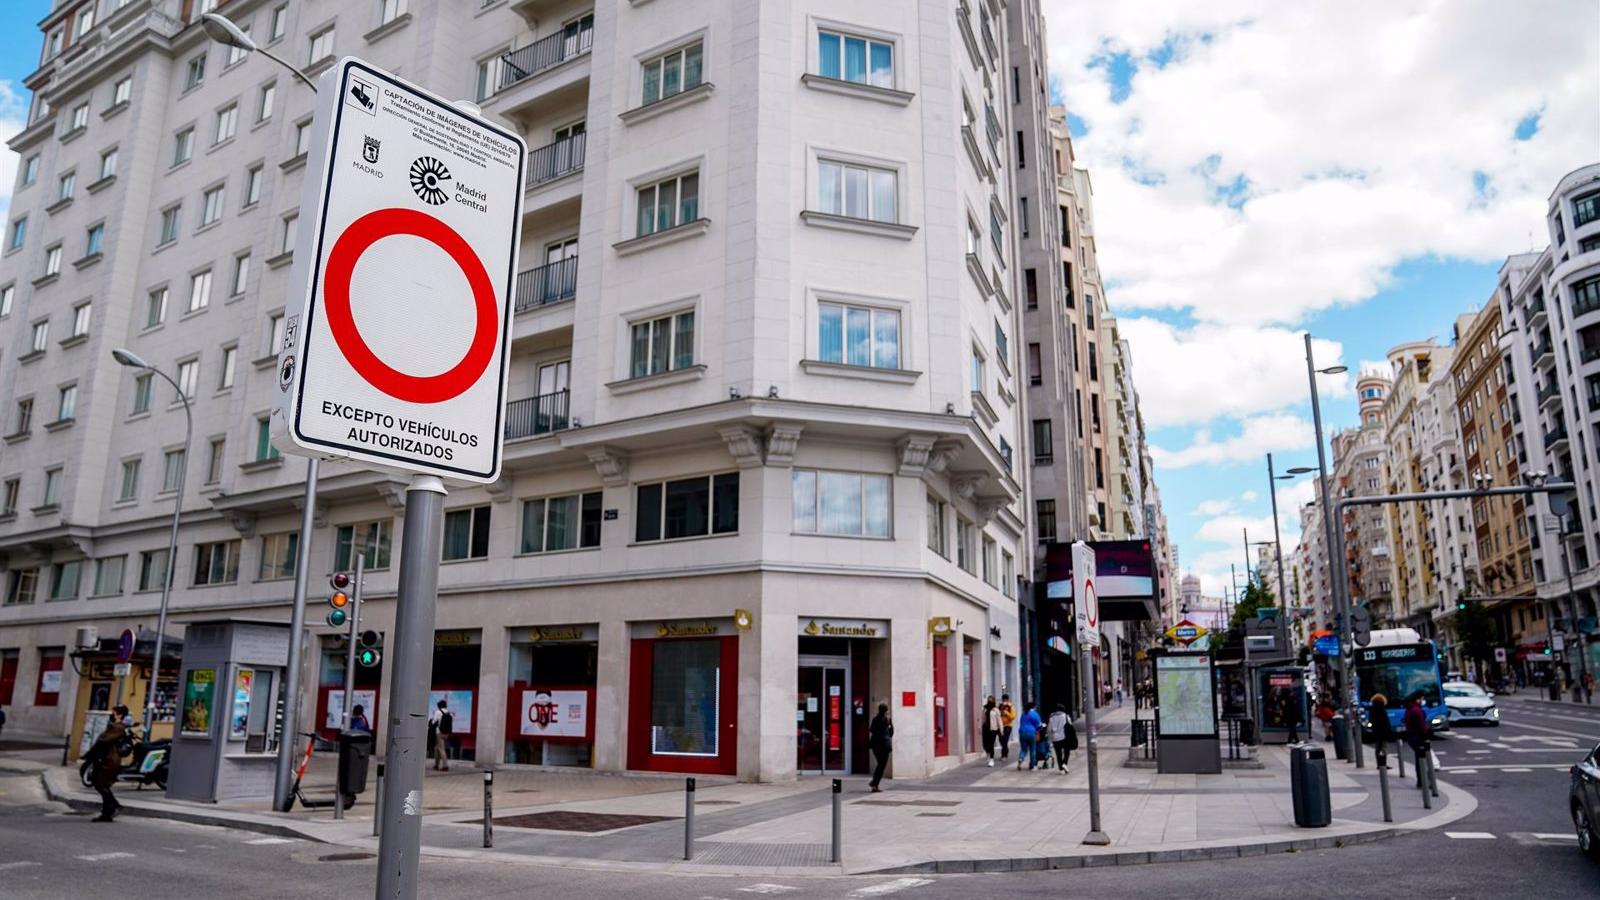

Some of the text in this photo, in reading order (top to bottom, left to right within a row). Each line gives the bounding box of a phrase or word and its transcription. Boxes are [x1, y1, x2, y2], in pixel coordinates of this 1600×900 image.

[384, 89, 517, 155] CAPTACIÓN DE IMÁGENES DE VEHÍCULOS
[352, 160, 384, 179] MADRID
[455, 181, 487, 202] Madrid
[454, 193, 487, 213] Central
[321, 400, 394, 429] EXCEPTO
[398, 417, 478, 448] VEHÍCULOS
[347, 427, 454, 461] AUTORIZADOS
[822, 622, 876, 636] Santander
